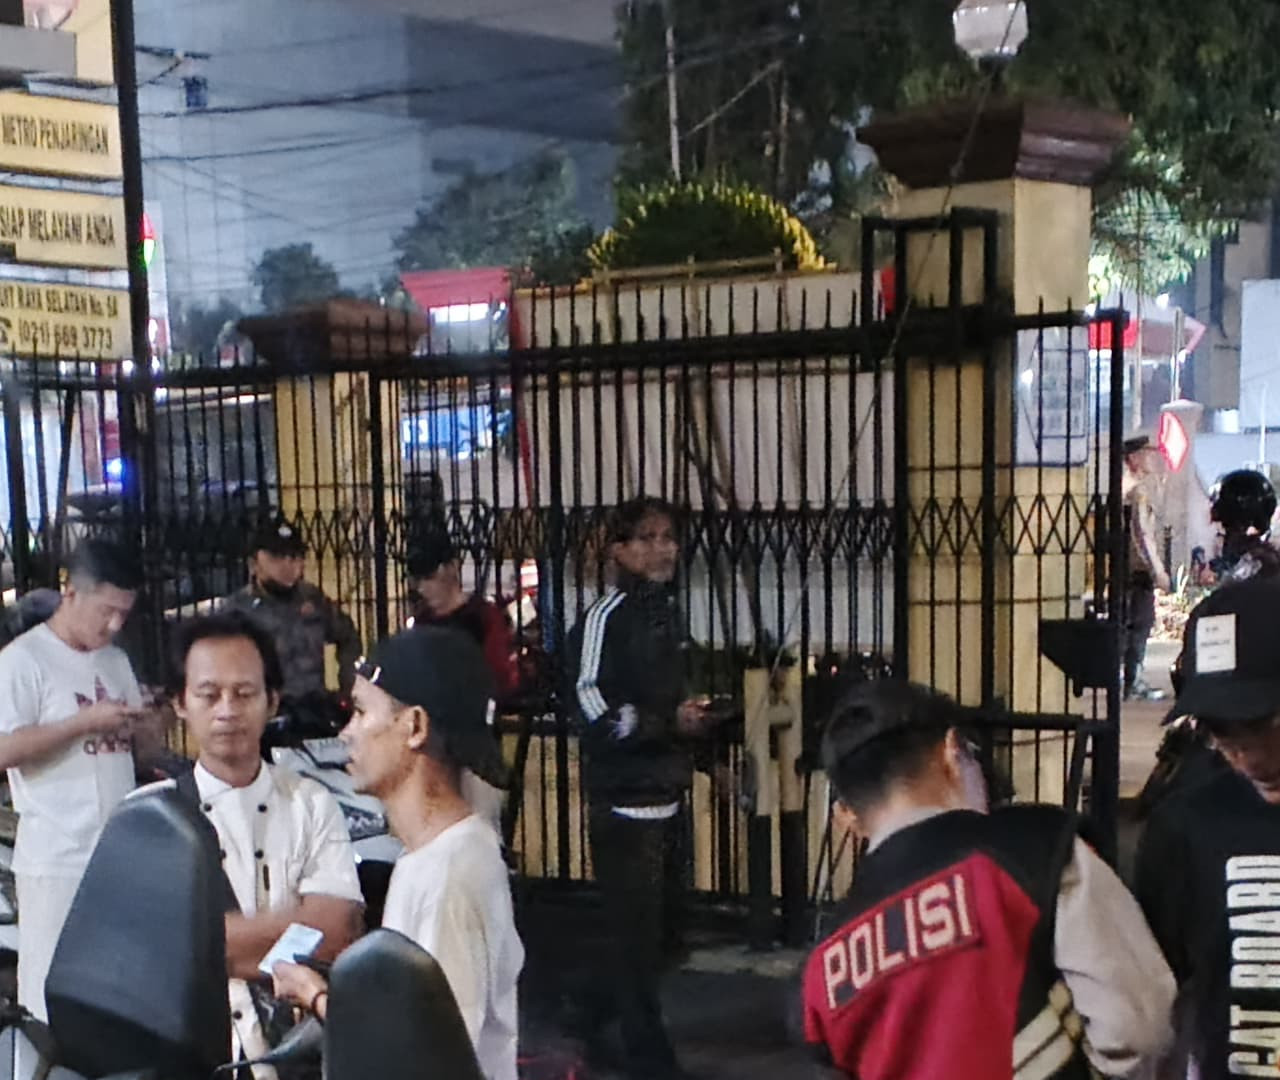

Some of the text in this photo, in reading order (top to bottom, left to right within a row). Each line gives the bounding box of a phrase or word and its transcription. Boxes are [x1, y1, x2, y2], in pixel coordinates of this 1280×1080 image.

[1, 113, 37, 147] METRO
[39, 117, 110, 155] PENJARINGAN
[27, 207, 83, 244] MELAYANI
[86, 213, 116, 247] ANDA
[17, 286, 43, 311] RAYA
[46, 289, 88, 315] SELATAN
[823, 873, 973, 1009] POLISI
